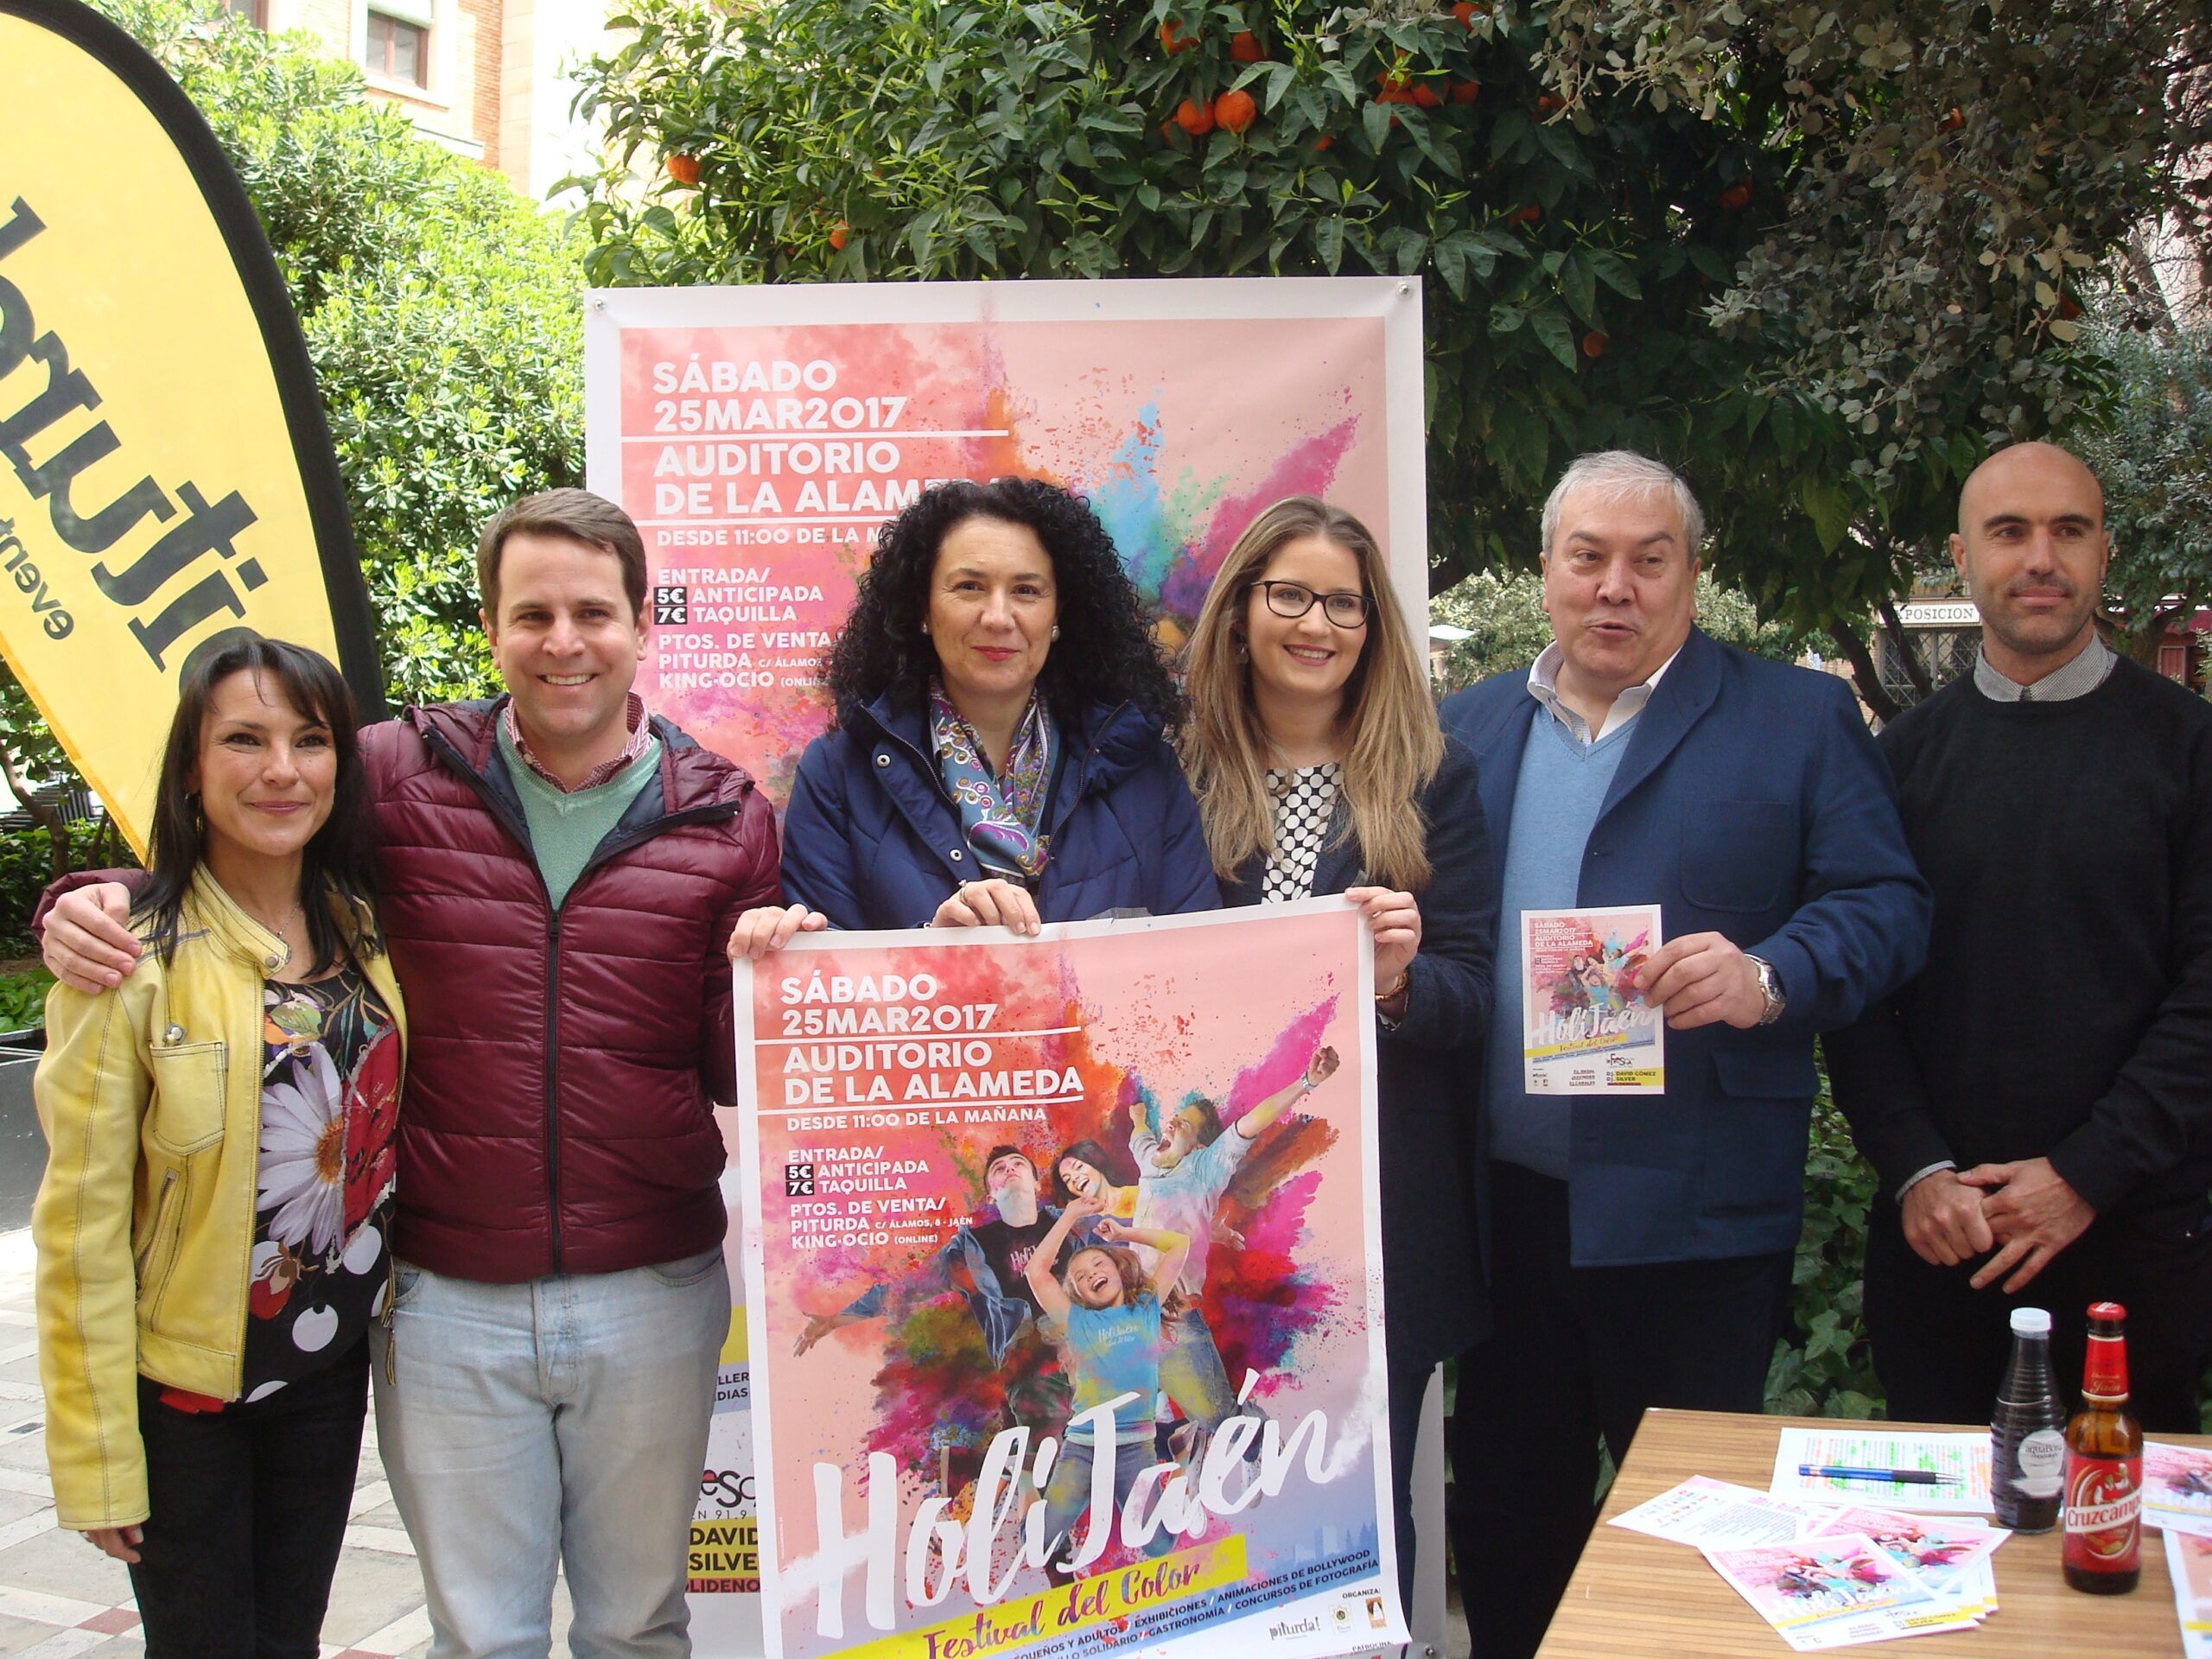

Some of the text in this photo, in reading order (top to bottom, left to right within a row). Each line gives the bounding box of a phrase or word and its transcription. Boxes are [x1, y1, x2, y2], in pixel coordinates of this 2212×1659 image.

[652, 353, 837, 394] SÁBADO
[653, 396, 908, 432] 25MAR2017
[653, 441, 900, 477] AUDITORIO
[655, 478, 976, 515] DE LA ALAM
[657, 530, 728, 547] DESDE
[734, 528, 790, 545] 11:00
[796, 527, 825, 543] DE
[831, 526, 860, 543] LA
[658, 567, 771, 584] ENTRADA/
[658, 586, 823, 604] 5€ ANTICIPADA
[658, 606, 797, 625] 7€ TAQUILLA
[1896, 607, 1974, 620] XPOSICION
[658, 632, 836, 650] PTOS. DE VENTA
[658, 652, 752, 669] PITURDA
[780, 677, 828, 688] (ONLI
[780, 969, 938, 1005] SÁBADO
[782, 1003, 998, 1036] 25MAR2017
[783, 1040, 992, 1073] AUDITORIO
[785, 1066, 1084, 1105] DE LA ALAMEDA
[786, 1105, 1046, 1131] DESDE 11:00 DE LA MAÑANA
[788, 1146, 884, 1162] ENTRADA/
[788, 1160, 930, 1179] 5€ ANTICIPADA
[789, 1178, 907, 1196] 7€ TAQUILLA
[790, 1197, 946, 1217] PTOS. DE VENTA/
[791, 1217, 870, 1233] PITURDA
[889, 1218, 933, 1229] ÁLAMOS,
[894, 1234, 938, 1245] (ONLINE)
[809, 1368, 1336, 1640] HoliJaén
[2068, 1495, 2143, 1527] Cruzcamp
[715, 1510, 747, 1519] 91.9
[689, 1528, 758, 1546] DAVID
[689, 1553, 758, 1571] SILVE
[685, 1579, 760, 1593] LIDENO
[1342, 1588, 1381, 1599] ORGANIZA:
[923, 1562, 1200, 1659] Festival del Color
[1014, 1640, 1065, 1659] QUEÑOS
[1135, 1599, 1207, 1630] EXHIBICIONES
[1217, 1573, 1289, 1603] ANIMACIONES
[1292, 1569, 1306, 1581] DE
[1307, 1549, 1371, 1575] BOLLYWOOD
[1083, 1634, 1138, 1657] SOLIDARIO
[1148, 1605, 1225, 1637] GASTRONOMÍA
[1235, 1585, 1296, 1611] CONCURSOS
[1300, 1578, 1313, 1589] DE
[1315, 1559, 1379, 1586] FOTOGRAFÍA
